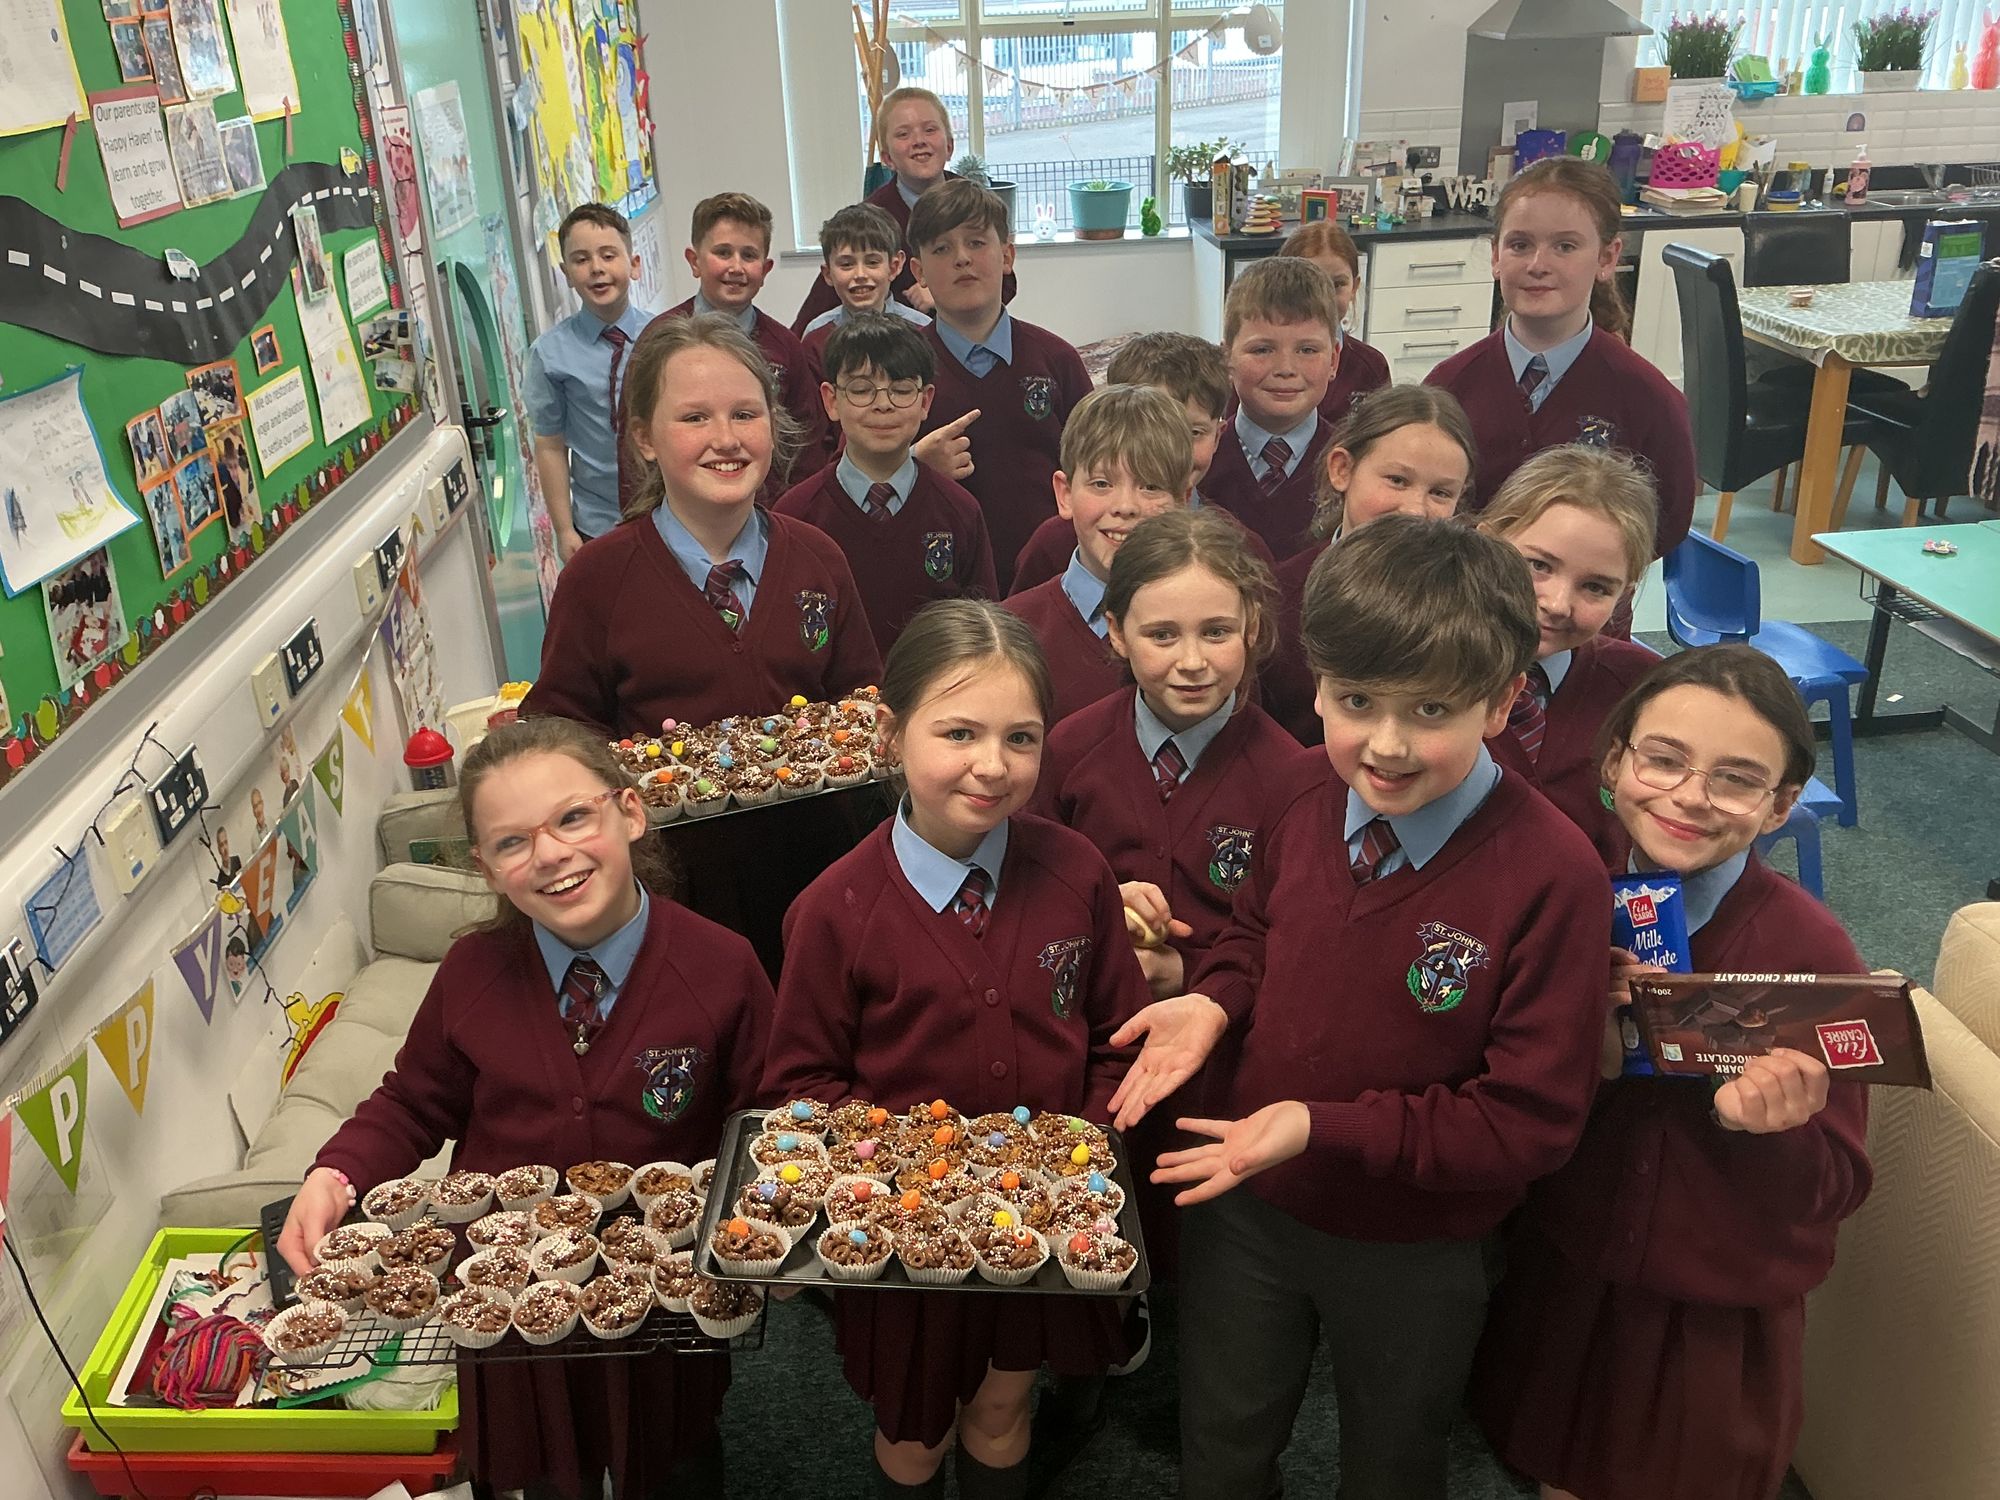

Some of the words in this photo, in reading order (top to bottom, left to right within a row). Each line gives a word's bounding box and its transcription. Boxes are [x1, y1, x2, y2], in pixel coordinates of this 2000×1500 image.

[96, 105, 111, 121] Our
[114, 102, 142, 122] parents
[144, 101, 156, 113] use
[155, 129, 164, 143] to
[111, 164, 131, 182] learn
[132, 159, 149, 177] and
[148, 159, 167, 177] grow
[1433, 923, 1447, 936] ST.
[1447, 931, 1484, 952] JOHN'S
[1629, 928, 1664, 952] Milk
[1048, 945, 1061, 954] ST.
[1713, 973, 1781, 982] CHOCOLATE
[1784, 974, 1816, 983] DARK
[648, 1049, 661, 1057] ST.
[661, 1047, 695, 1056] JOHN'S
[1714, 1064, 1744, 1074] DARK
